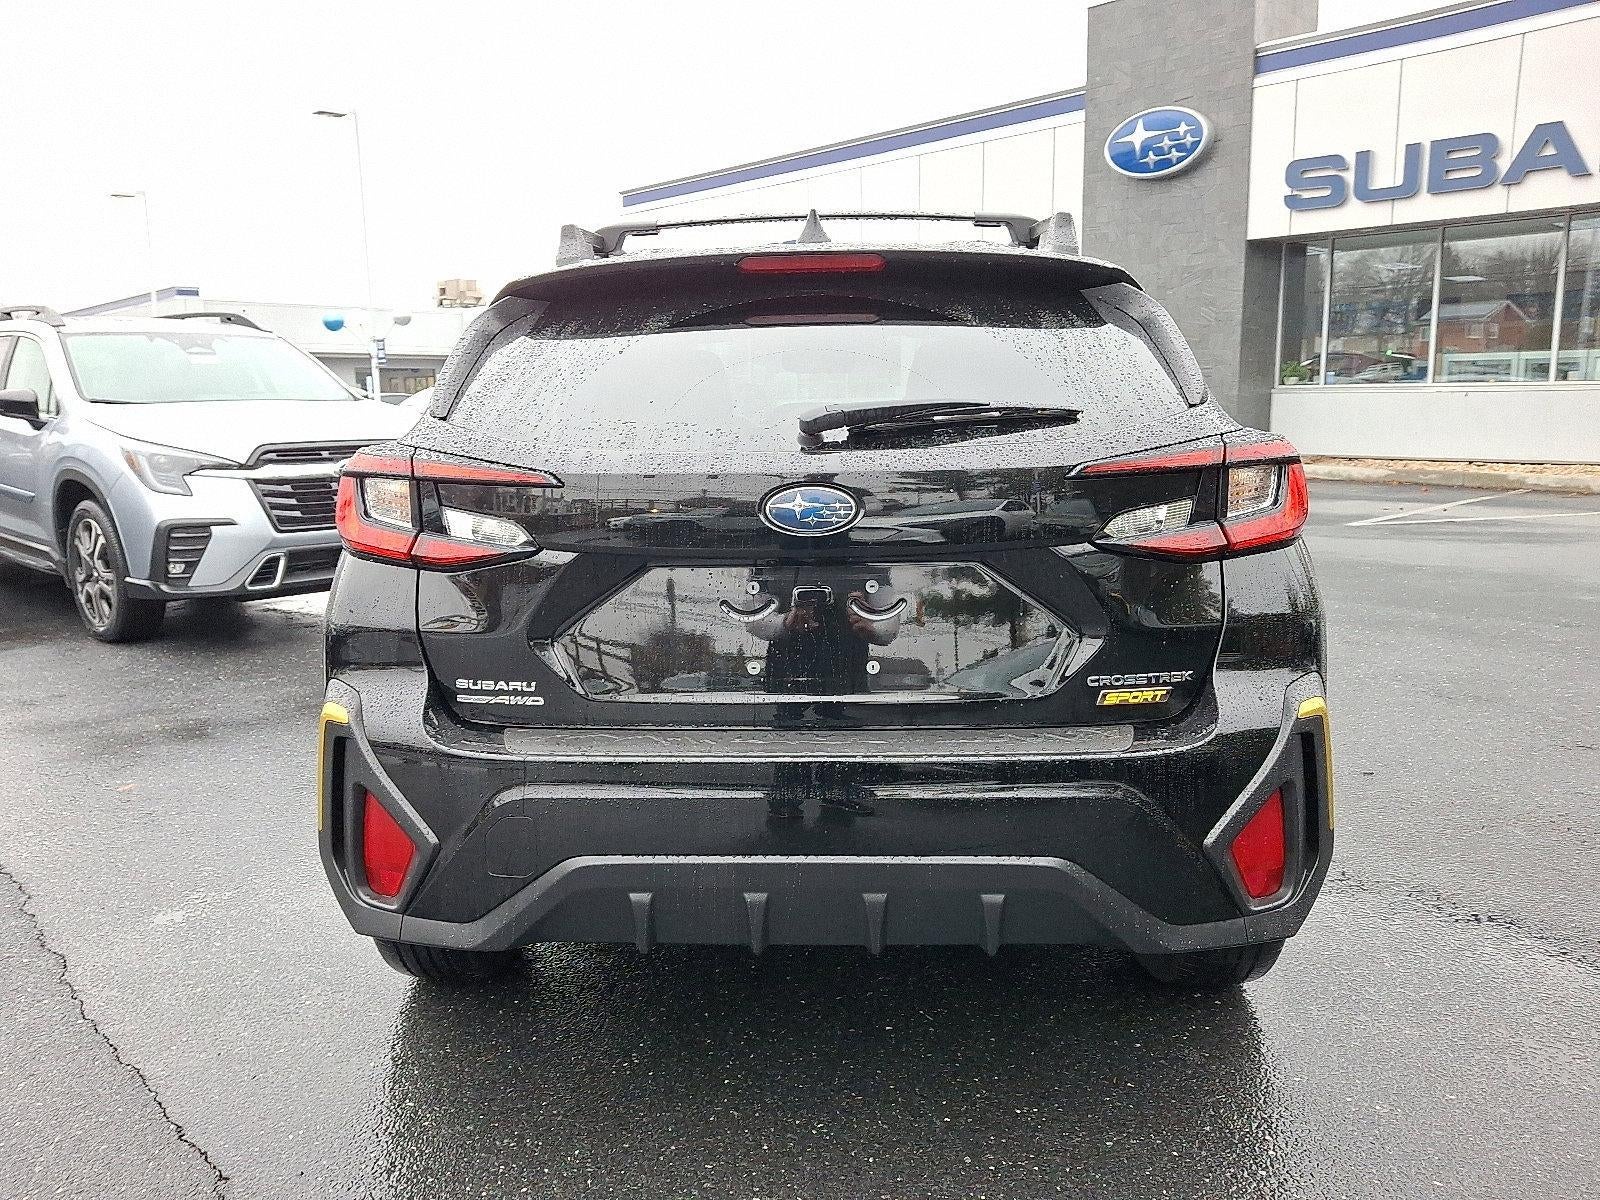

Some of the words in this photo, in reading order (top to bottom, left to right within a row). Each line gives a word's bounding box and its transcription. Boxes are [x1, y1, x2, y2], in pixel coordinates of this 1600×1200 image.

[1284, 120, 1600, 211] SUBA
[455, 678, 537, 692] SUBARU
[1086, 670, 1194, 687] CROSSTREK
[488, 695, 545, 706] AWD
[1103, 690, 1168, 704] SPORT
